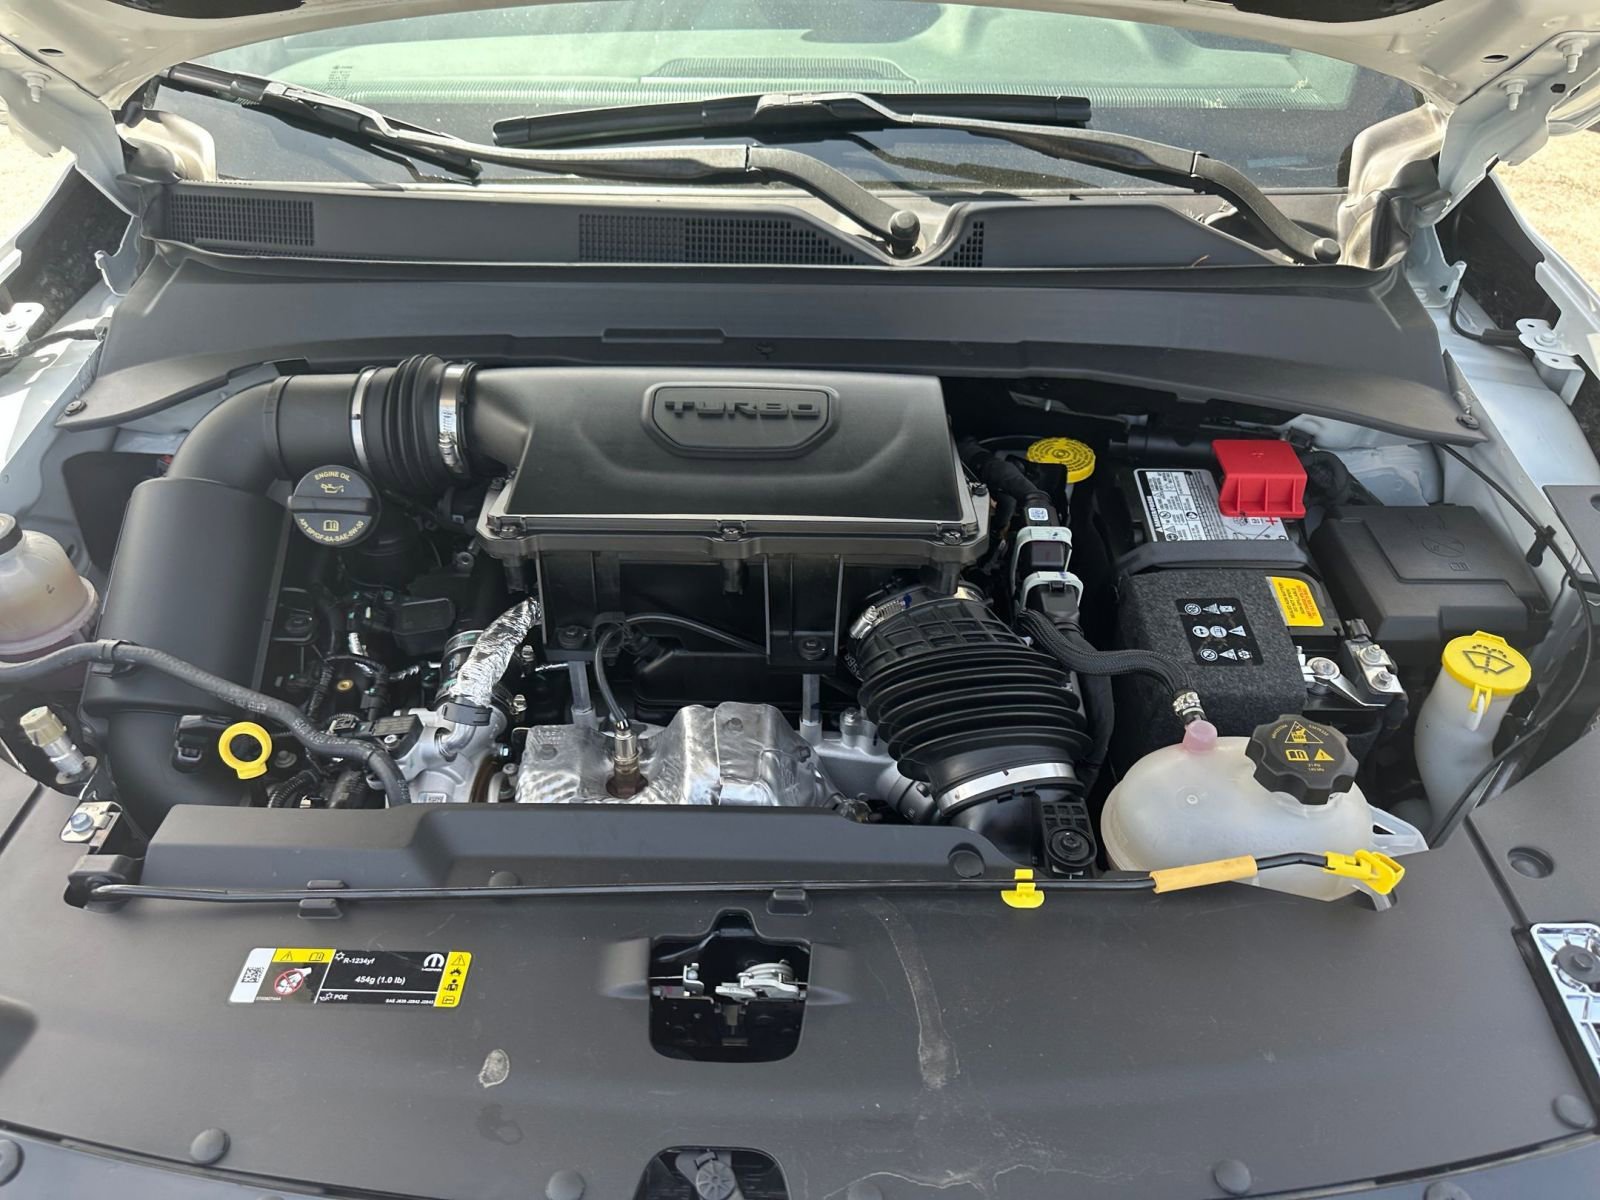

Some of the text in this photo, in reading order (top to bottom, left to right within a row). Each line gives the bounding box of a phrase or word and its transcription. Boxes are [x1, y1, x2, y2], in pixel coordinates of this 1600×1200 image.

[664, 400, 821, 419] TURBO
[314, 471, 351, 482] ENGINE OIL
[343, 956, 375, 966] R-1234yf
[355, 975, 406, 985] 454g (1.0 lb)
